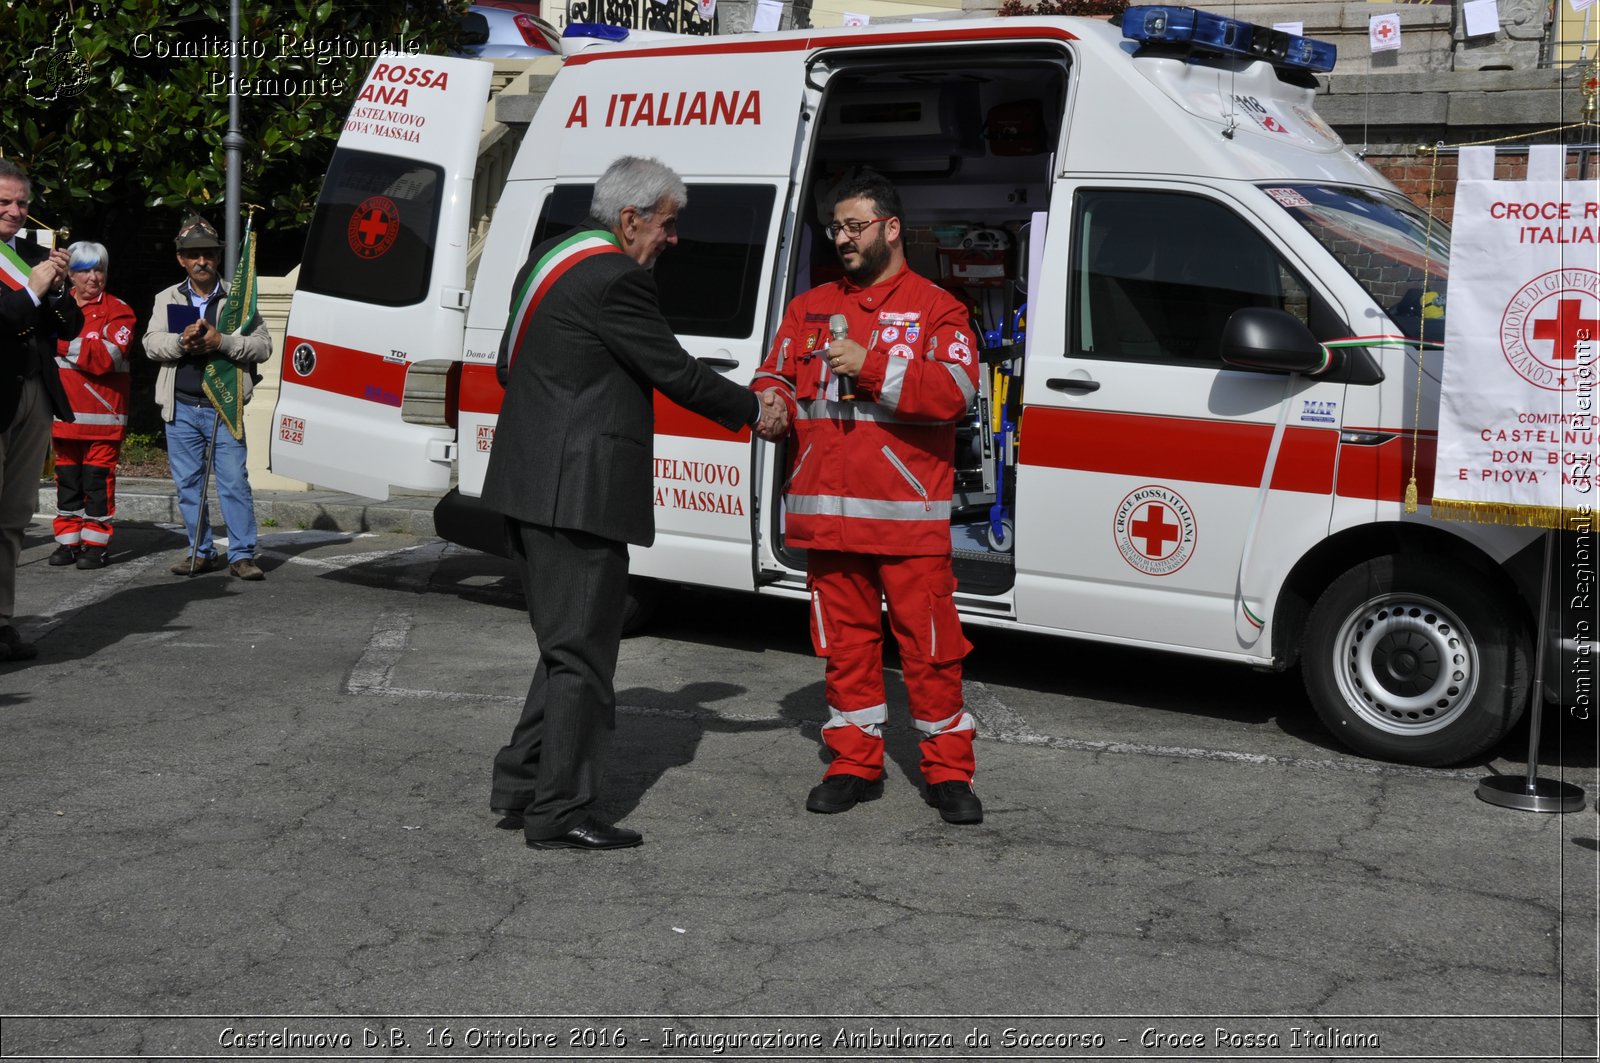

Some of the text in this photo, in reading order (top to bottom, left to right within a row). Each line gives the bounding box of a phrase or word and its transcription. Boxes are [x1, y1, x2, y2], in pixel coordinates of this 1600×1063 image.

[372, 63, 449, 91] ROSSA
[357, 84, 409, 107] ANA
[565, 90, 761, 128] A ITALIANA
[372, 124, 421, 144] MASSAIA
[1490, 201, 1572, 220] CROCE
[1519, 226, 1600, 244] ITALIA
[1524, 283, 1544, 301] DI
[1504, 297, 1553, 385] CONVENZIONE
[390, 349, 407, 359] TDI
[465, 349, 496, 359] Dono di
[1302, 400, 1337, 415] MAF
[282, 417, 304, 431] AT 14
[1518, 413, 1584, 427] COMITATO
[478, 426, 489, 437] AT
[1481, 428, 1600, 445] CASTELNU
[1492, 450, 1533, 464] DON
[653, 457, 740, 487] TELNUOVO
[1459, 468, 1468, 480] E
[653, 485, 745, 516] A' MASSAIA
[1117, 489, 1194, 543] CROCE ROSSA ITALIANA
[1122, 536, 1143, 563] COMITATO
